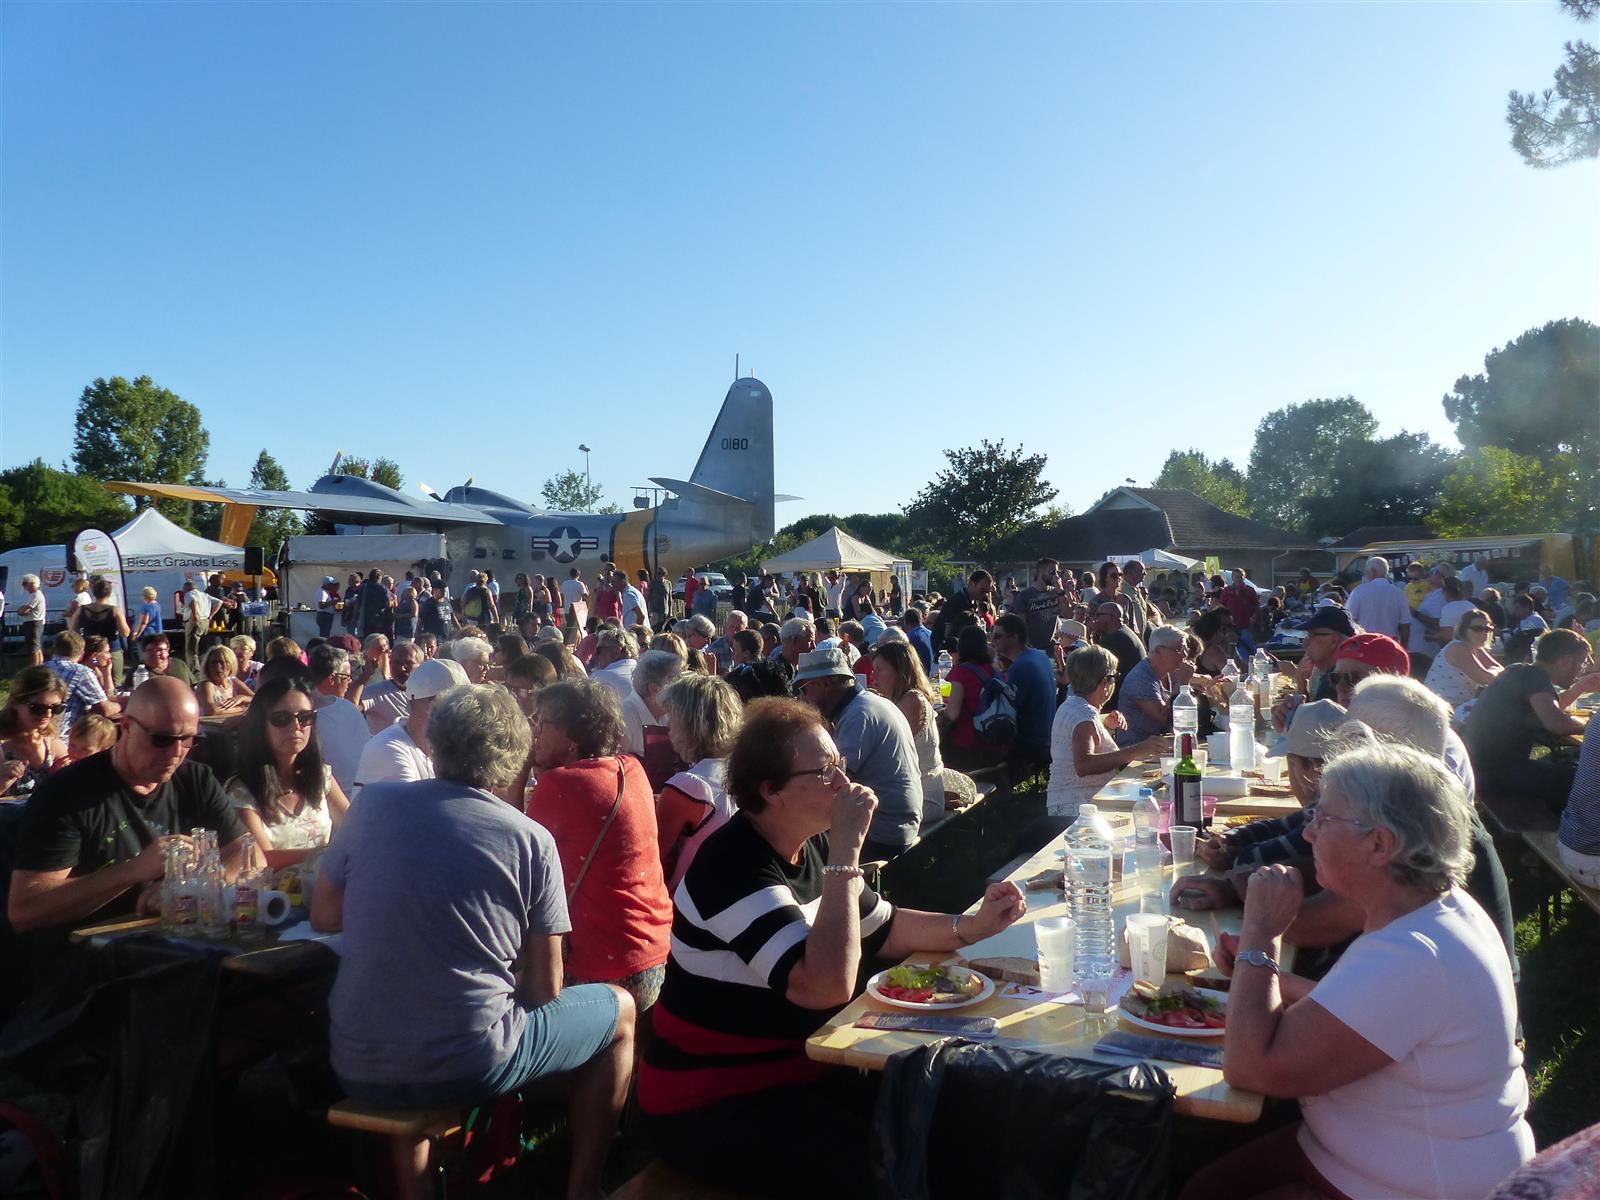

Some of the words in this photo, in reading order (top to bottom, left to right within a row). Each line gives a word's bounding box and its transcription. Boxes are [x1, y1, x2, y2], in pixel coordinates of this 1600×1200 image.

[721, 438, 749, 450] 0180
[127, 557, 160, 567] Bisca
[163, 556, 208, 567] Grands
[212, 557, 239, 567] Lacs
